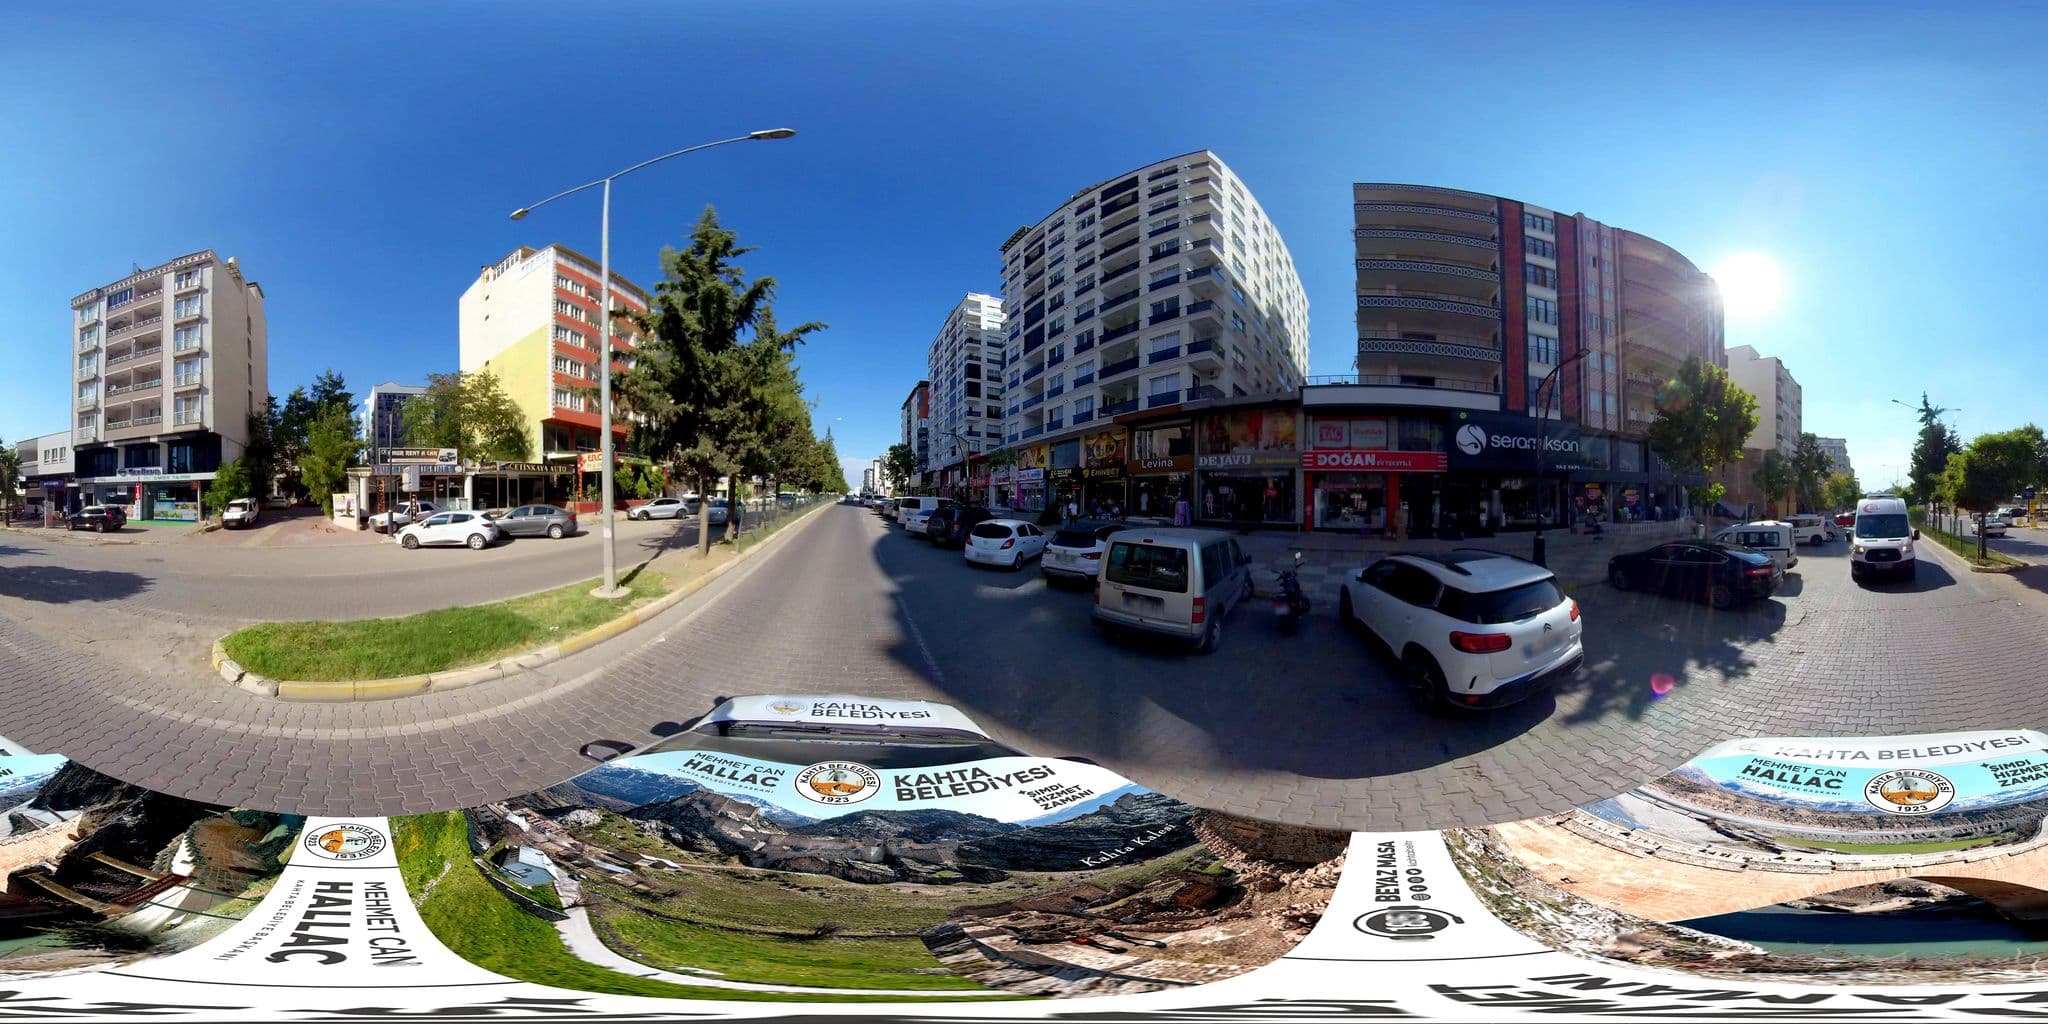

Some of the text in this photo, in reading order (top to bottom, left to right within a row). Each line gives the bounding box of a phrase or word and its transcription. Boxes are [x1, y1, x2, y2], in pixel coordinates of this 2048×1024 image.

[550, 464, 567, 473] AUTO
[1141, 458, 1174, 469] Levina
[1317, 452, 1376, 466] DOĞAN
[813, 702, 882, 711] KAHTA
[694, 752, 785, 776] MEHMET CAN
[1751, 757, 1848, 778] MEHMET CAN
[799, 765, 826, 784] KAHTA
[893, 766, 992, 788] KAHTA
[1869, 774, 1894, 794] KAHTA
[820, 795, 850, 803] 1923
[1040, 789, 1095, 811] ZAMANI
[1897, 804, 1928, 812] 1923
[340, 825, 374, 836] KAHTA
[1080, 823, 1177, 867] Kahta Kalesi
[1375, 840, 1401, 902] BEYAZ MASA
[288, 879, 305, 900] KAHTA
[364, 881, 424, 967] MEHMET CAN
